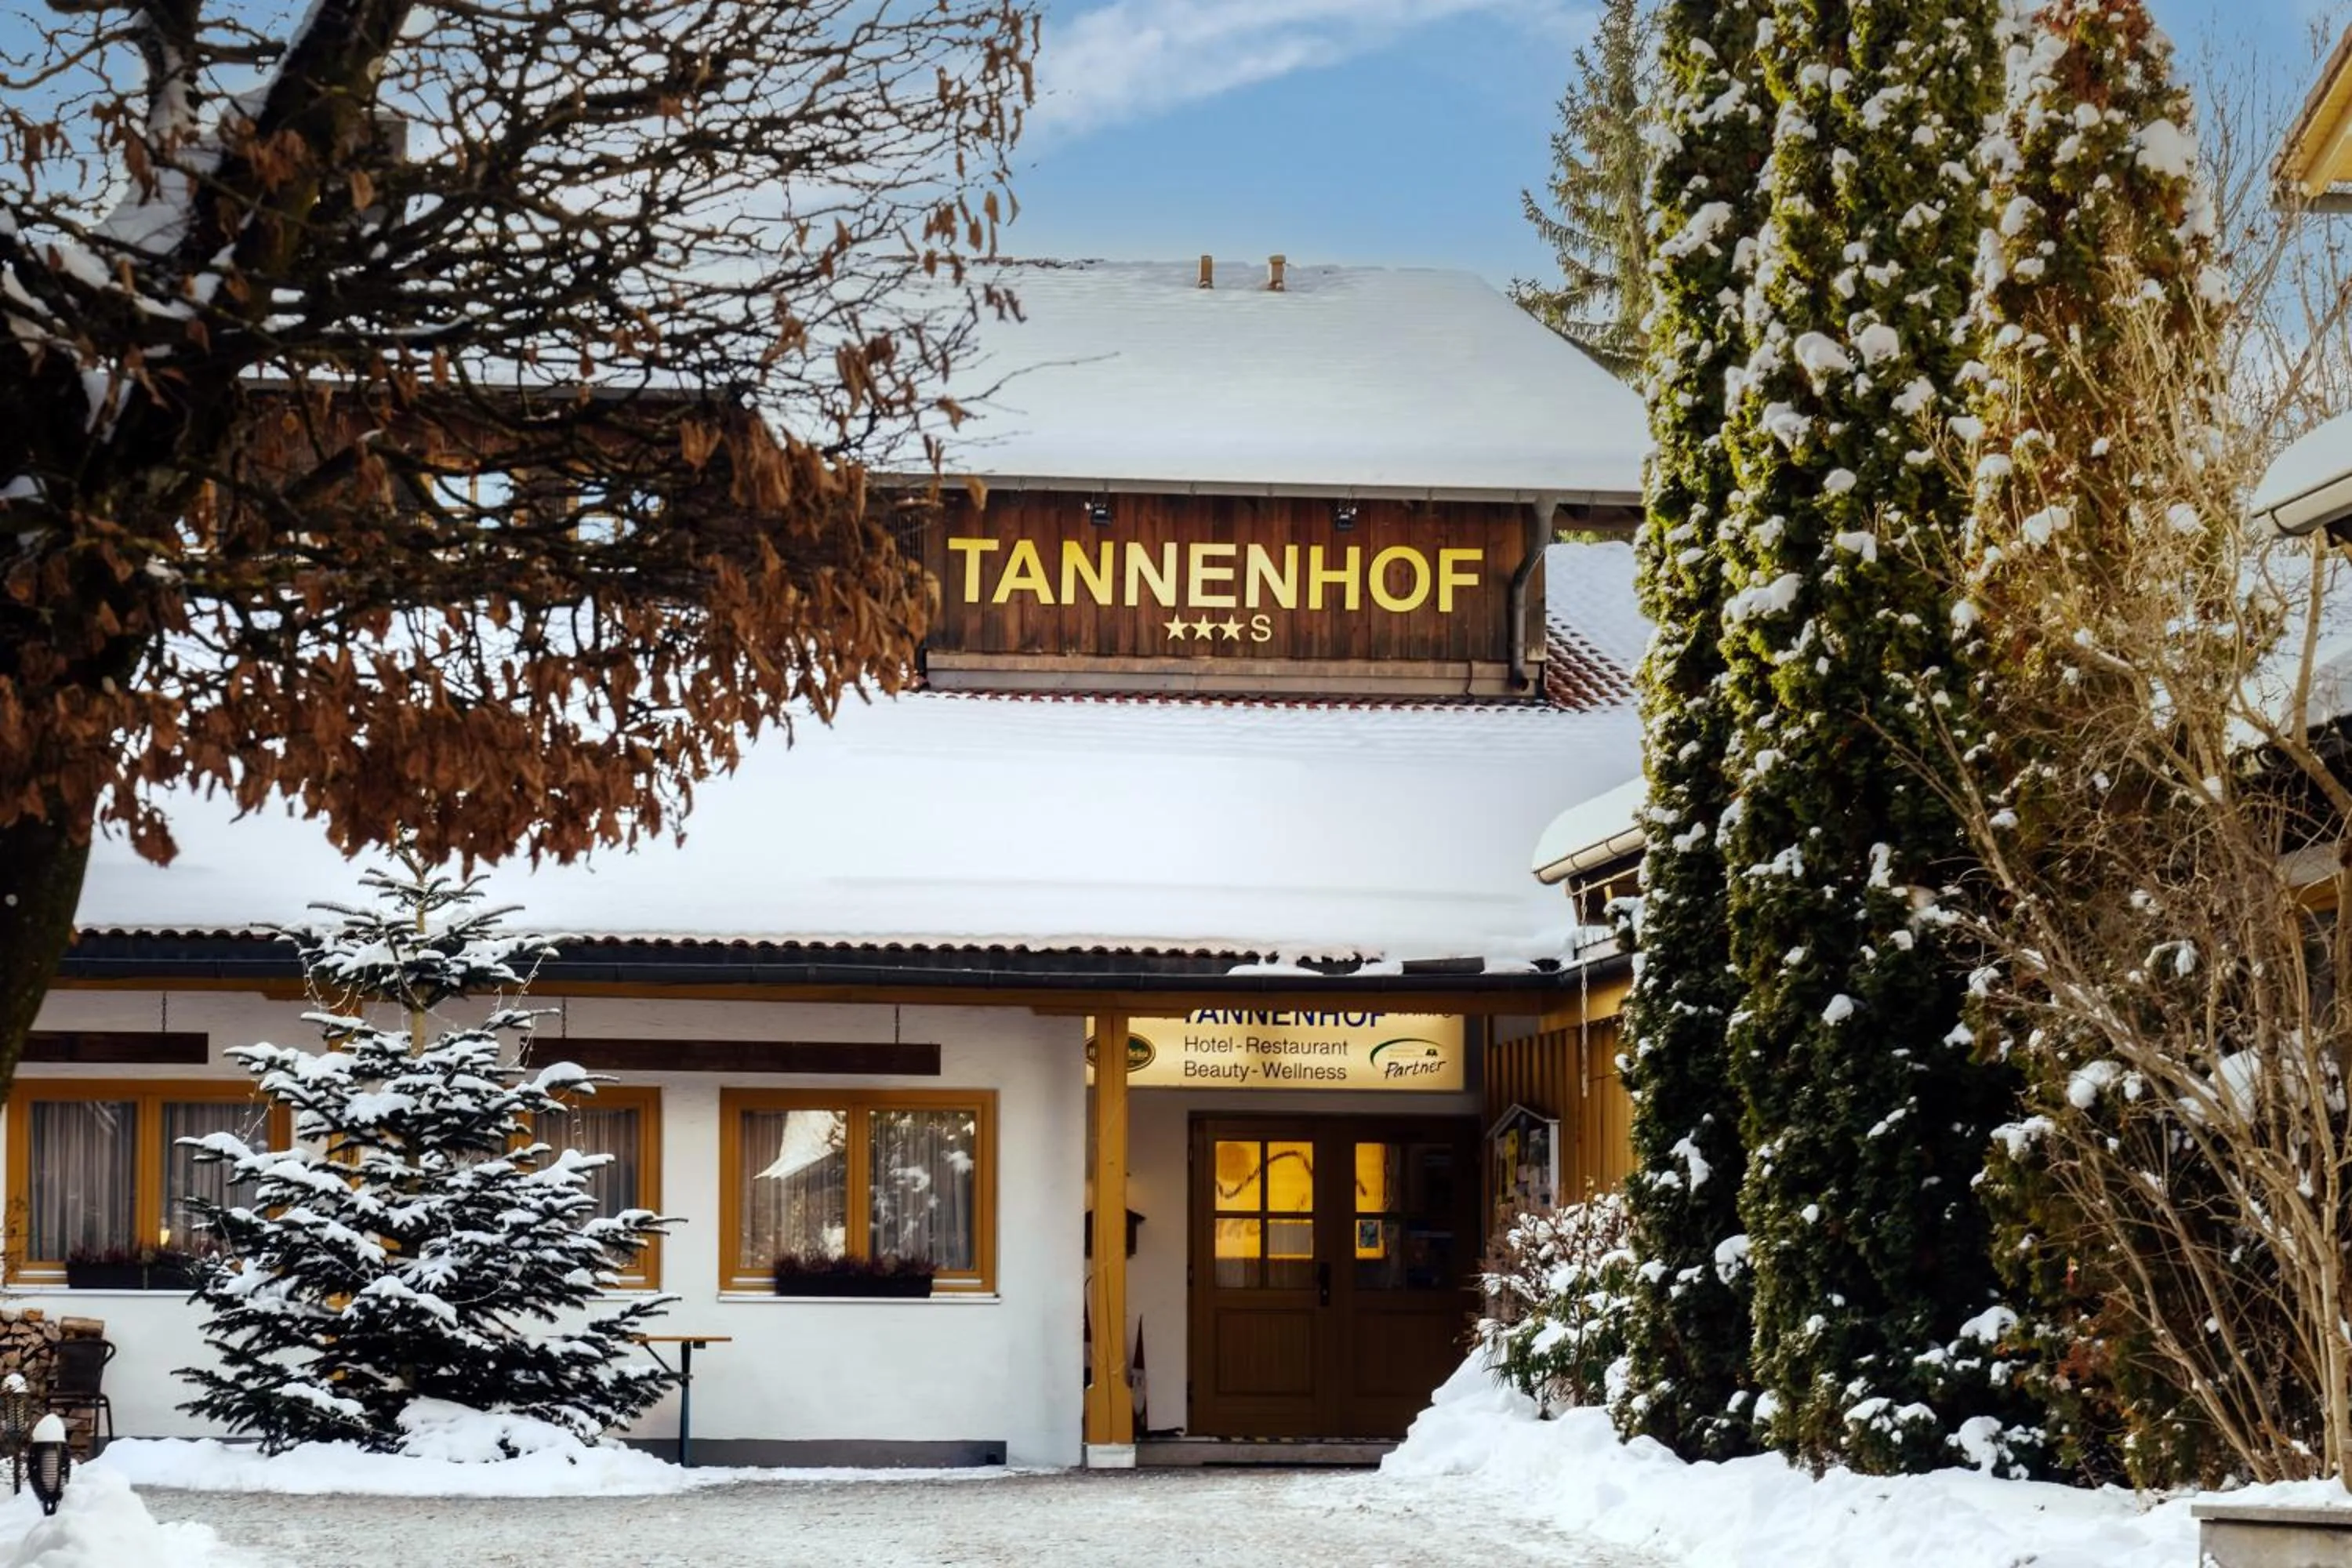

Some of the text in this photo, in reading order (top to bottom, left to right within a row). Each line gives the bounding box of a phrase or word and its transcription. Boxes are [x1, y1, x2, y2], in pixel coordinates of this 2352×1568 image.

[948, 537, 1483, 613] TANNENHOF
[1250, 614, 1273, 643] S
[1185, 1008, 1385, 1028] ANNENHOF
[1384, 1060, 1446, 1080] Partner
